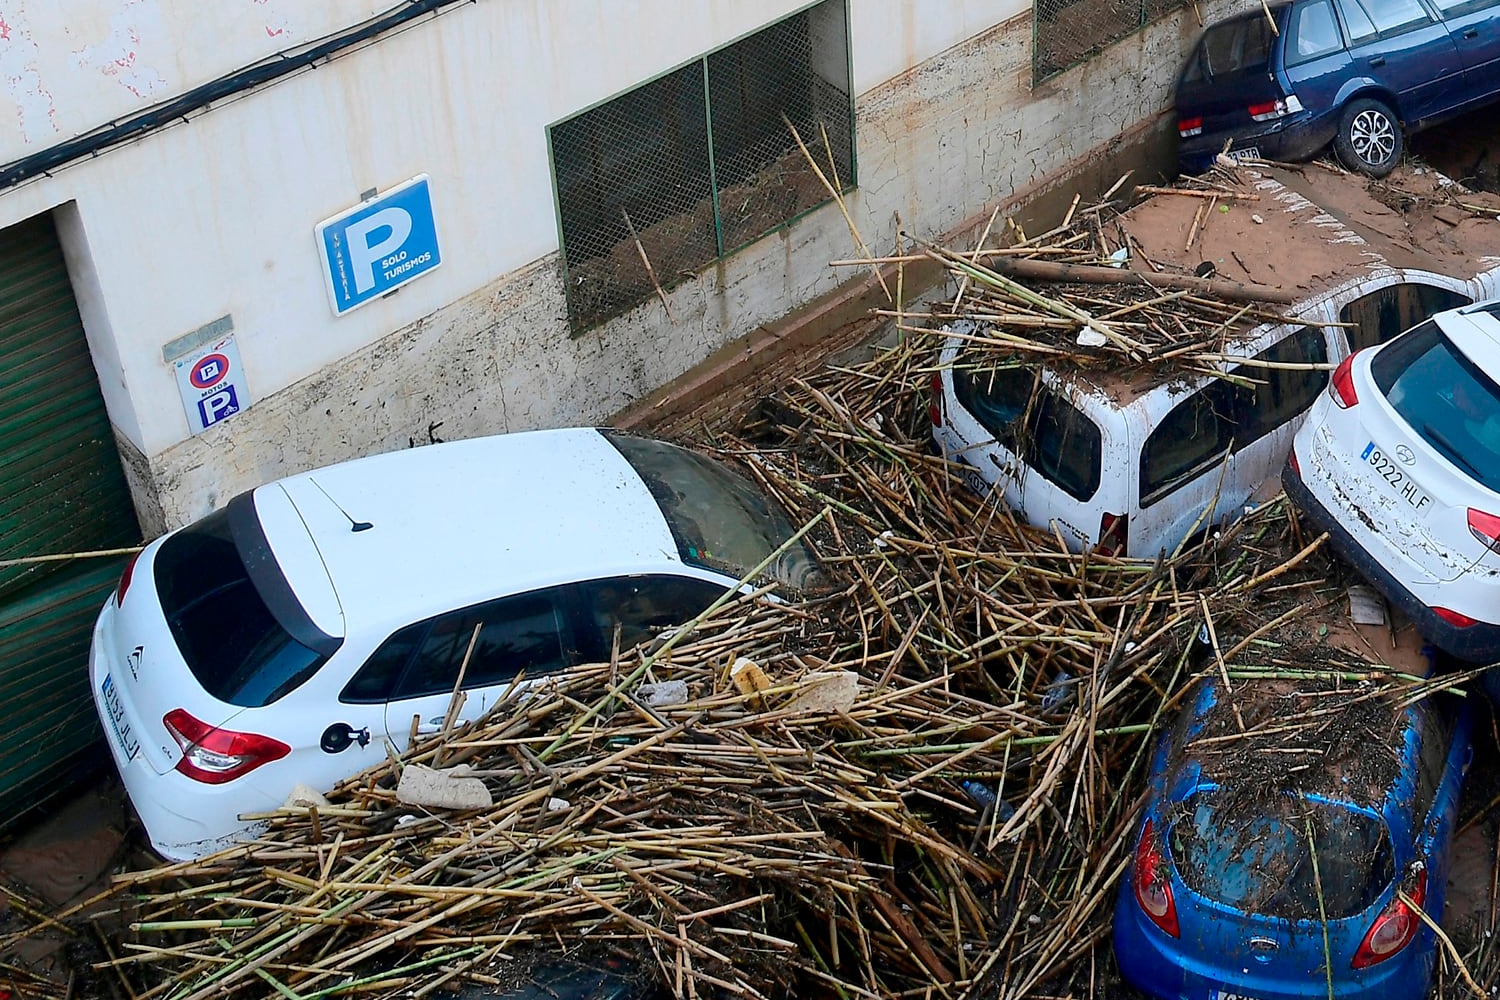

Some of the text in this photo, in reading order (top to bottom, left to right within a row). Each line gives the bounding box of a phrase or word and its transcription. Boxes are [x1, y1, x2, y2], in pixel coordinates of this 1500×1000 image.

[345, 207, 412, 295] P
[382, 250, 407, 269] SOLO
[384, 251, 431, 280] TURISMOS
[202, 381, 228, 397] MOTOS
[1370, 451, 1430, 509] 9222 HLF
